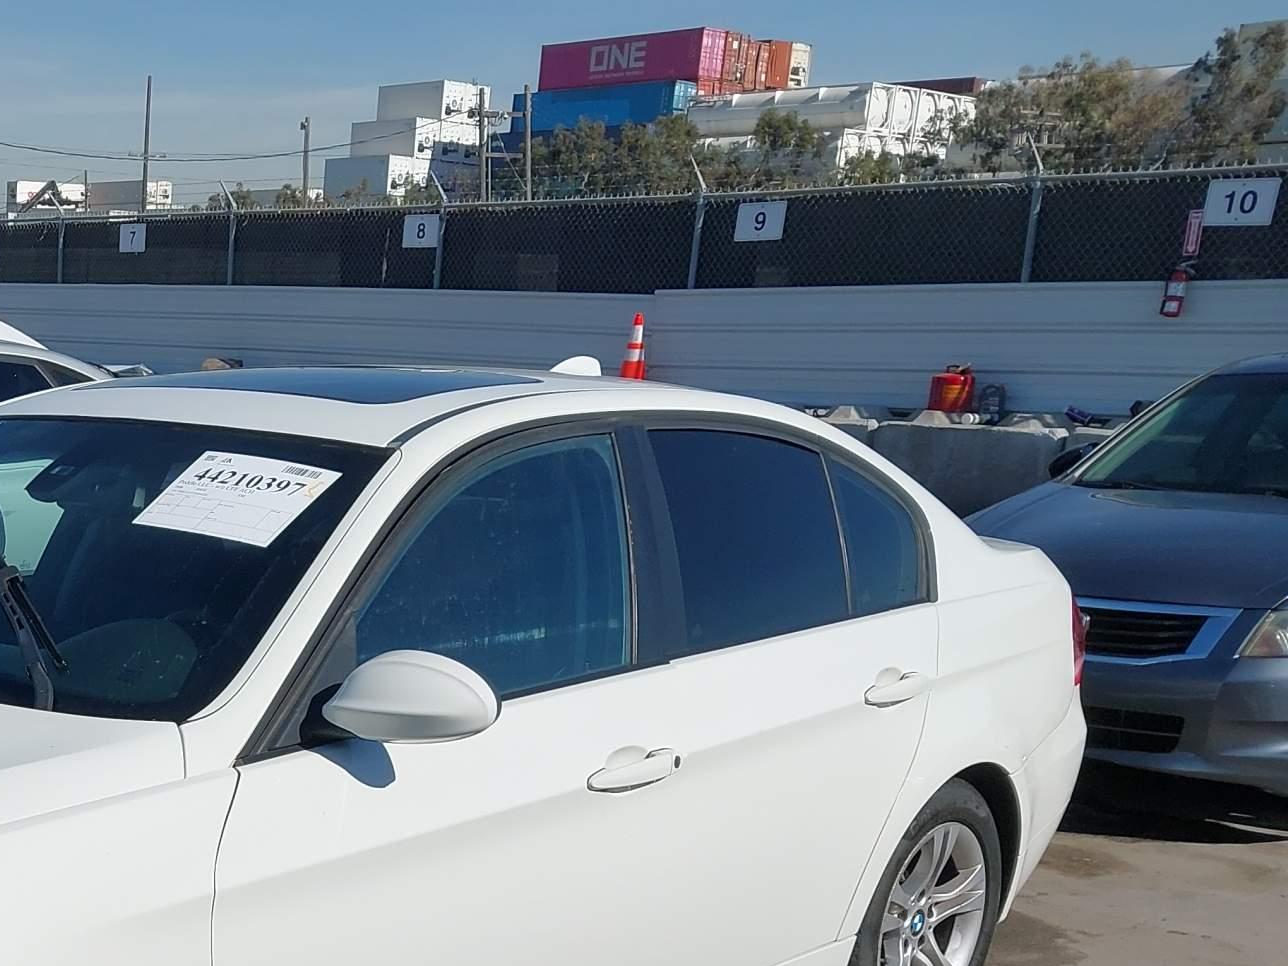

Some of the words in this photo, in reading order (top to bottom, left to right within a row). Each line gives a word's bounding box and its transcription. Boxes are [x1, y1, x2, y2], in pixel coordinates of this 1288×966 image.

[589, 41, 648, 72] ONE
[1224, 190, 1258, 214] 10
[416, 223, 426, 239] 8
[754, 211, 766, 231] 9
[130, 231, 137, 246] 7
[193, 467, 308, 496] 44210397
